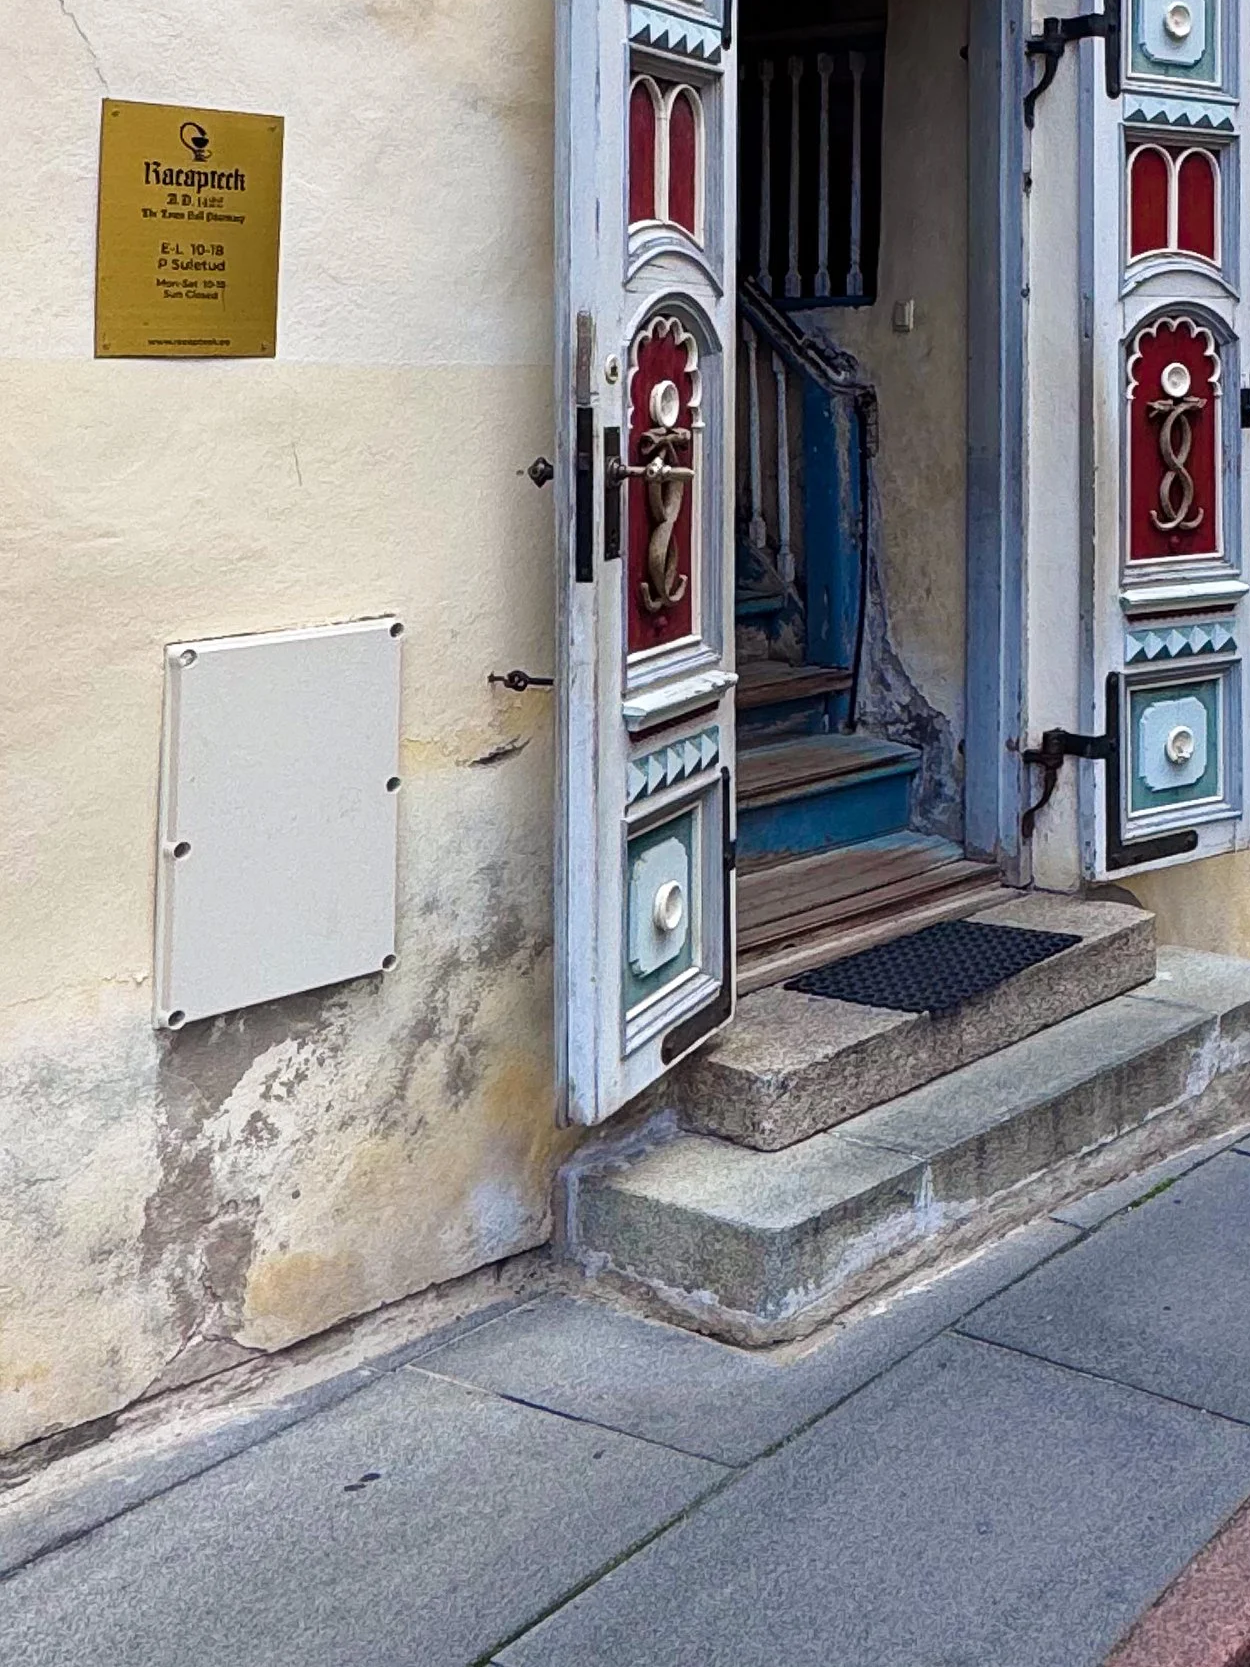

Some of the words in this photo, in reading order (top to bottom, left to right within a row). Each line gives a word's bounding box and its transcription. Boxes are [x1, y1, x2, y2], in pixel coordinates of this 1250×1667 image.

[161, 242, 184, 255] E-L
[190, 243, 224, 256] 10-18
[157, 257, 168, 270] P
[171, 258, 225, 272] Suletud
